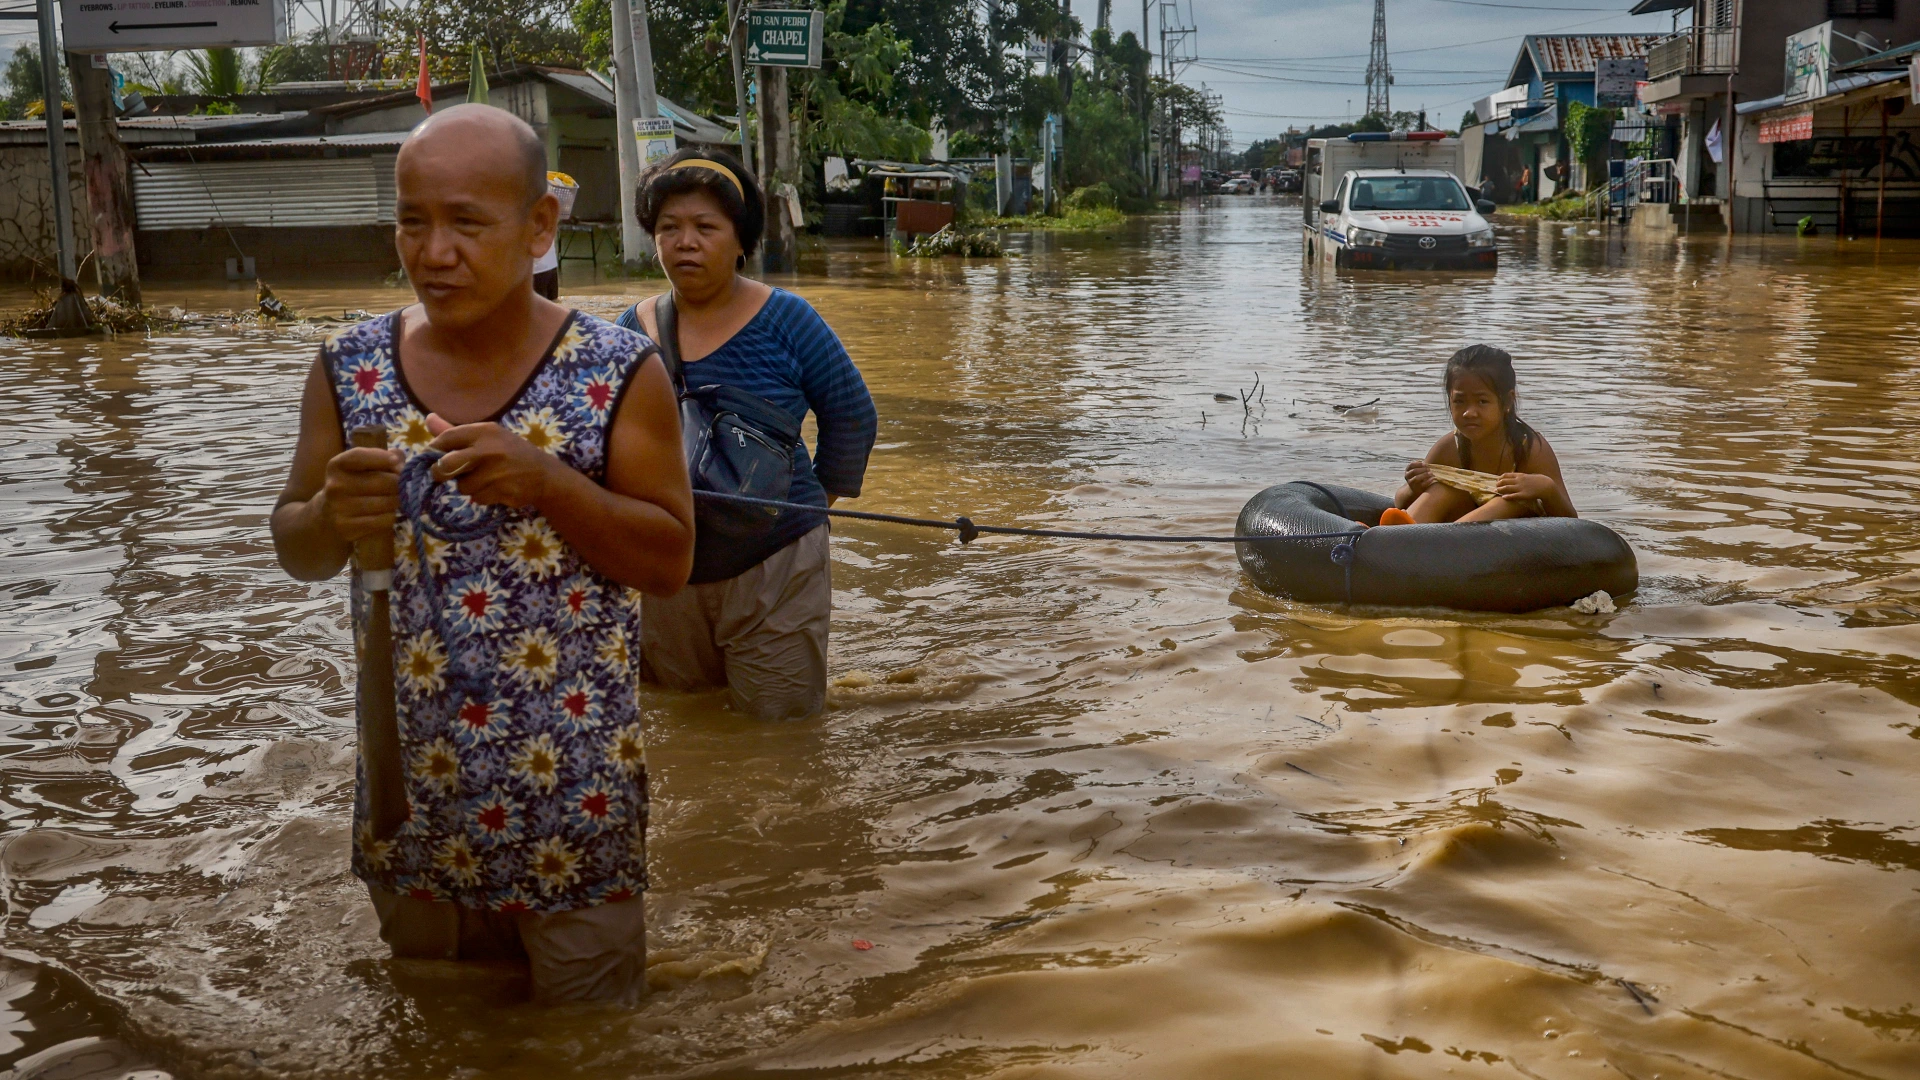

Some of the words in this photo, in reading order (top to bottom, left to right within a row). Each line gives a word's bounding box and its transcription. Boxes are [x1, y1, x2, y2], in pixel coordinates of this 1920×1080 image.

[751, 16, 762, 25] TO
[763, 16, 779, 26] SAN
[782, 16, 807, 27] PEDRO
[762, 29, 806, 46] CHAPEL
